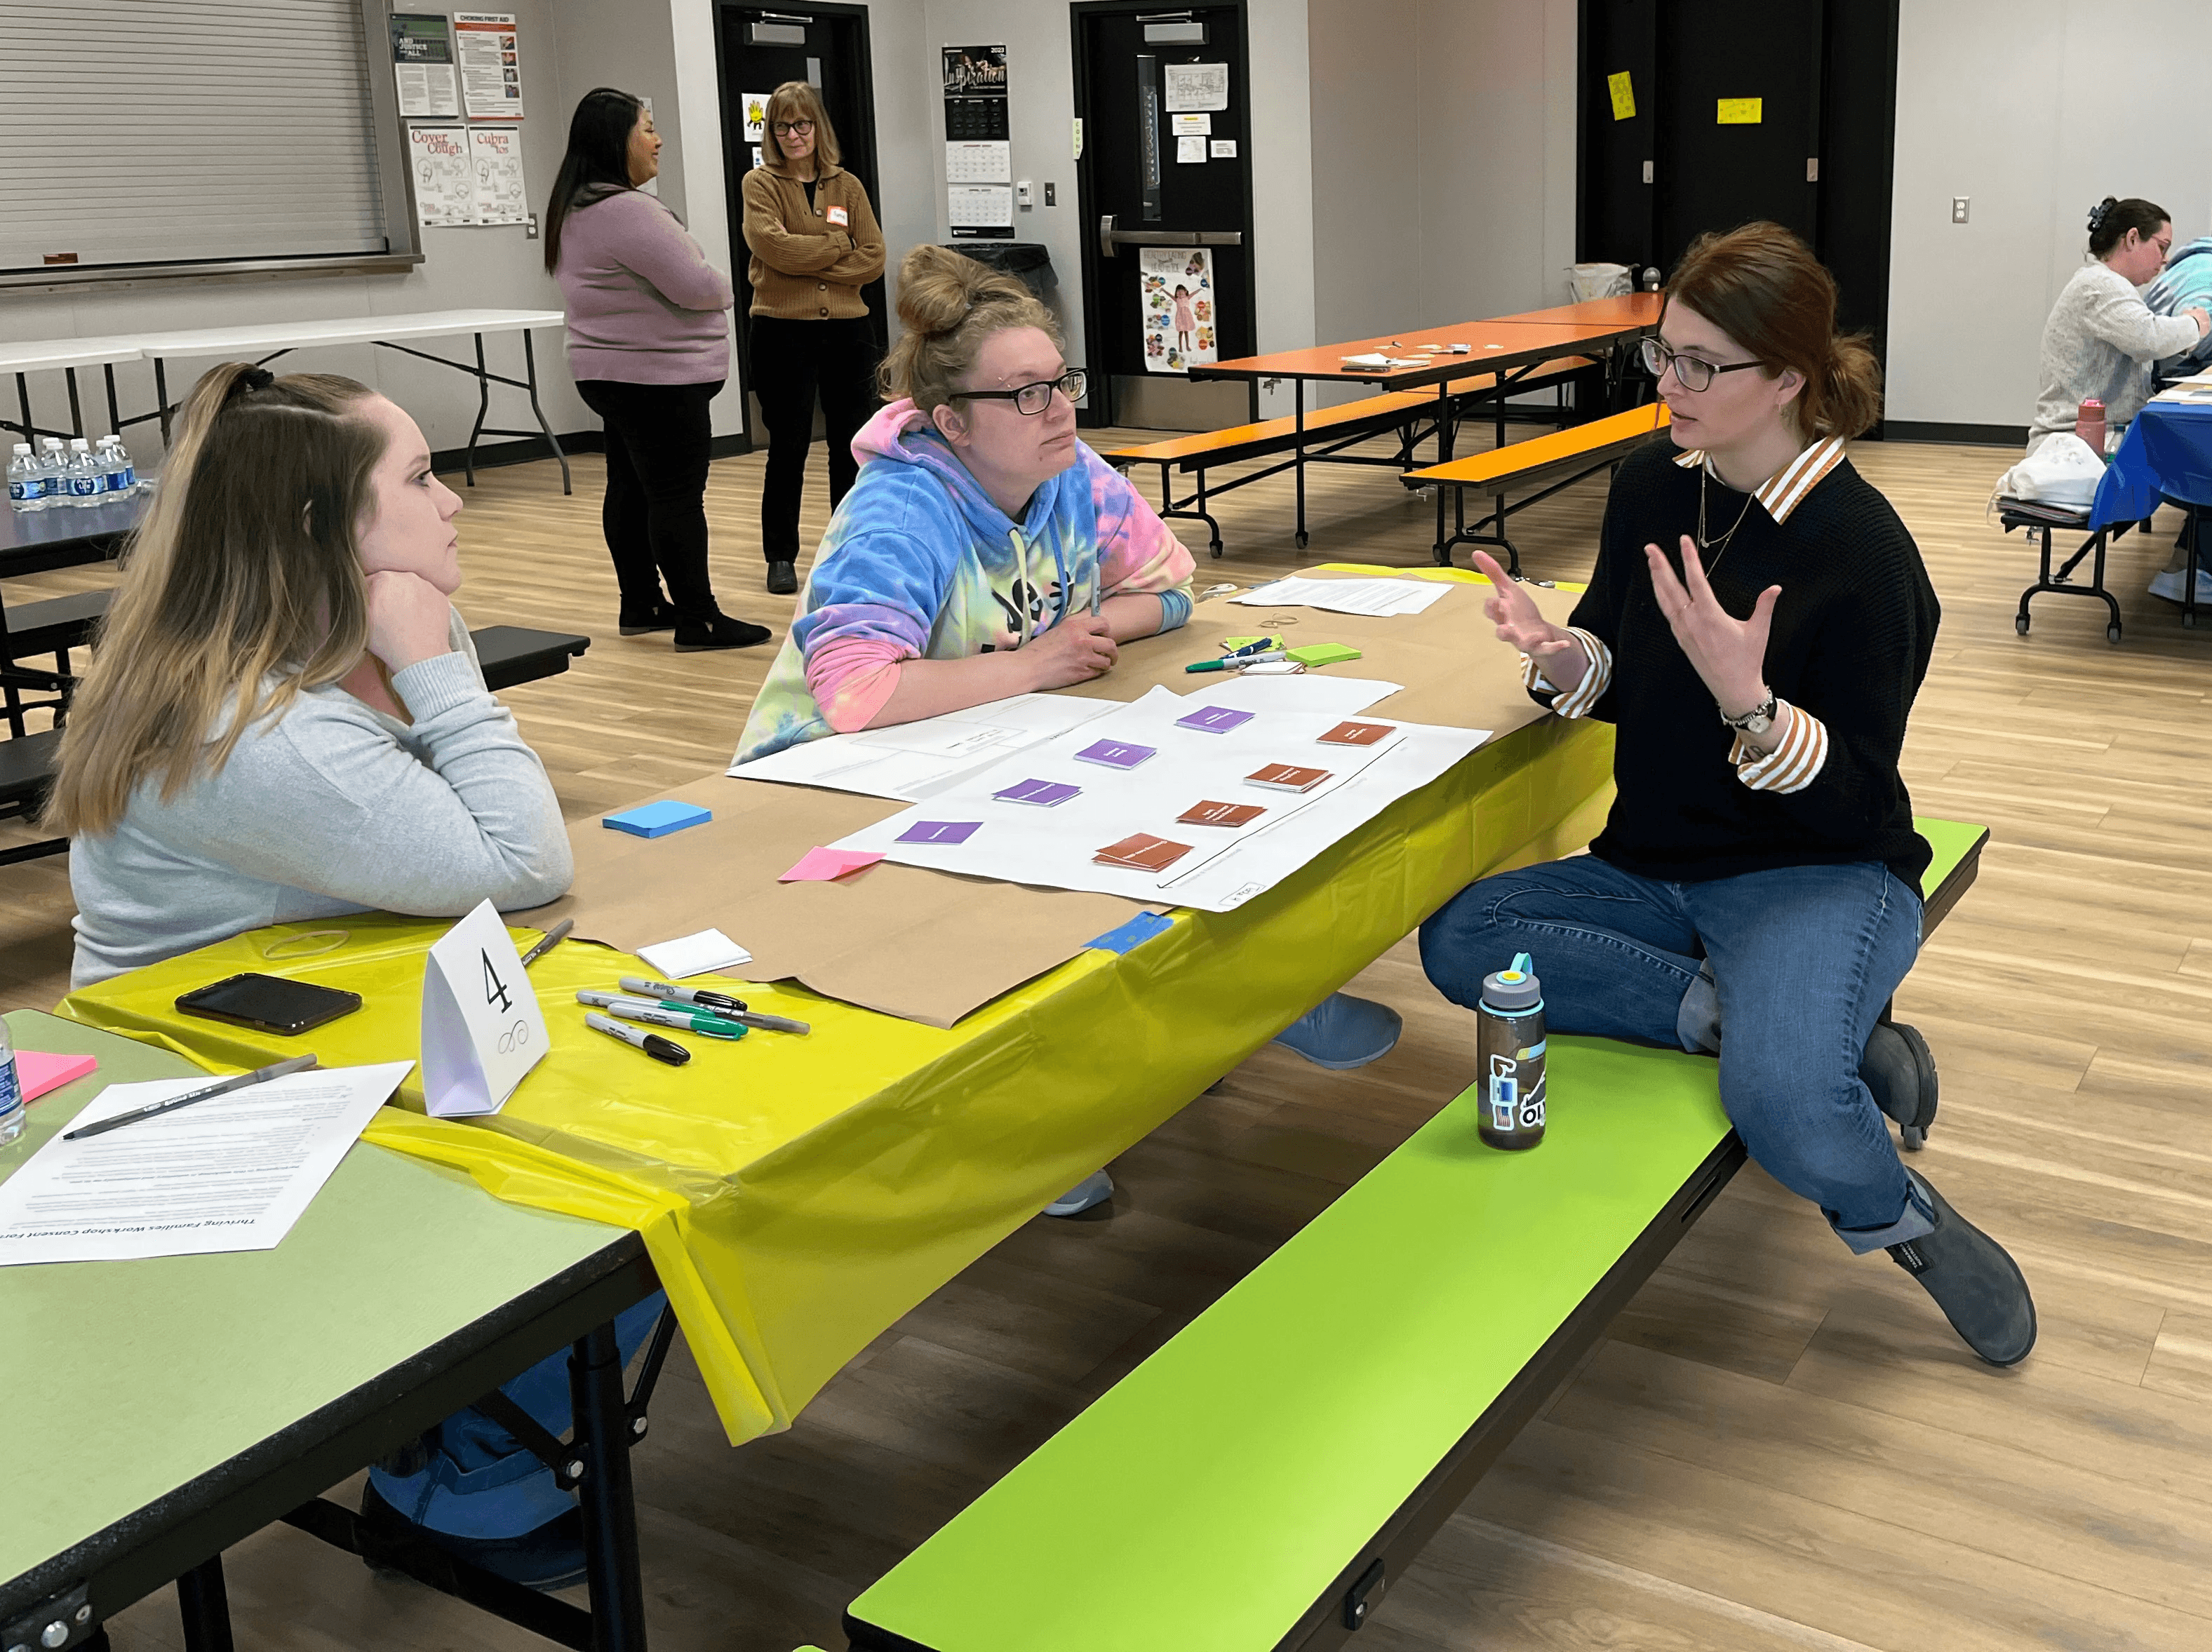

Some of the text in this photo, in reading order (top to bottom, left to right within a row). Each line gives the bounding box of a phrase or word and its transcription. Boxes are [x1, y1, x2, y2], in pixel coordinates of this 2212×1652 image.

[412, 130, 448, 143] Cover
[477, 133, 509, 145] Cubra
[427, 142, 463, 156] Cough
[481, 948, 513, 1014] 4
[148, 1221, 201, 1231] Families
[203, 1218, 256, 1227] Thriving
[27, 1230, 79, 1238] Consent
[81, 1226, 146, 1235] Workshop
